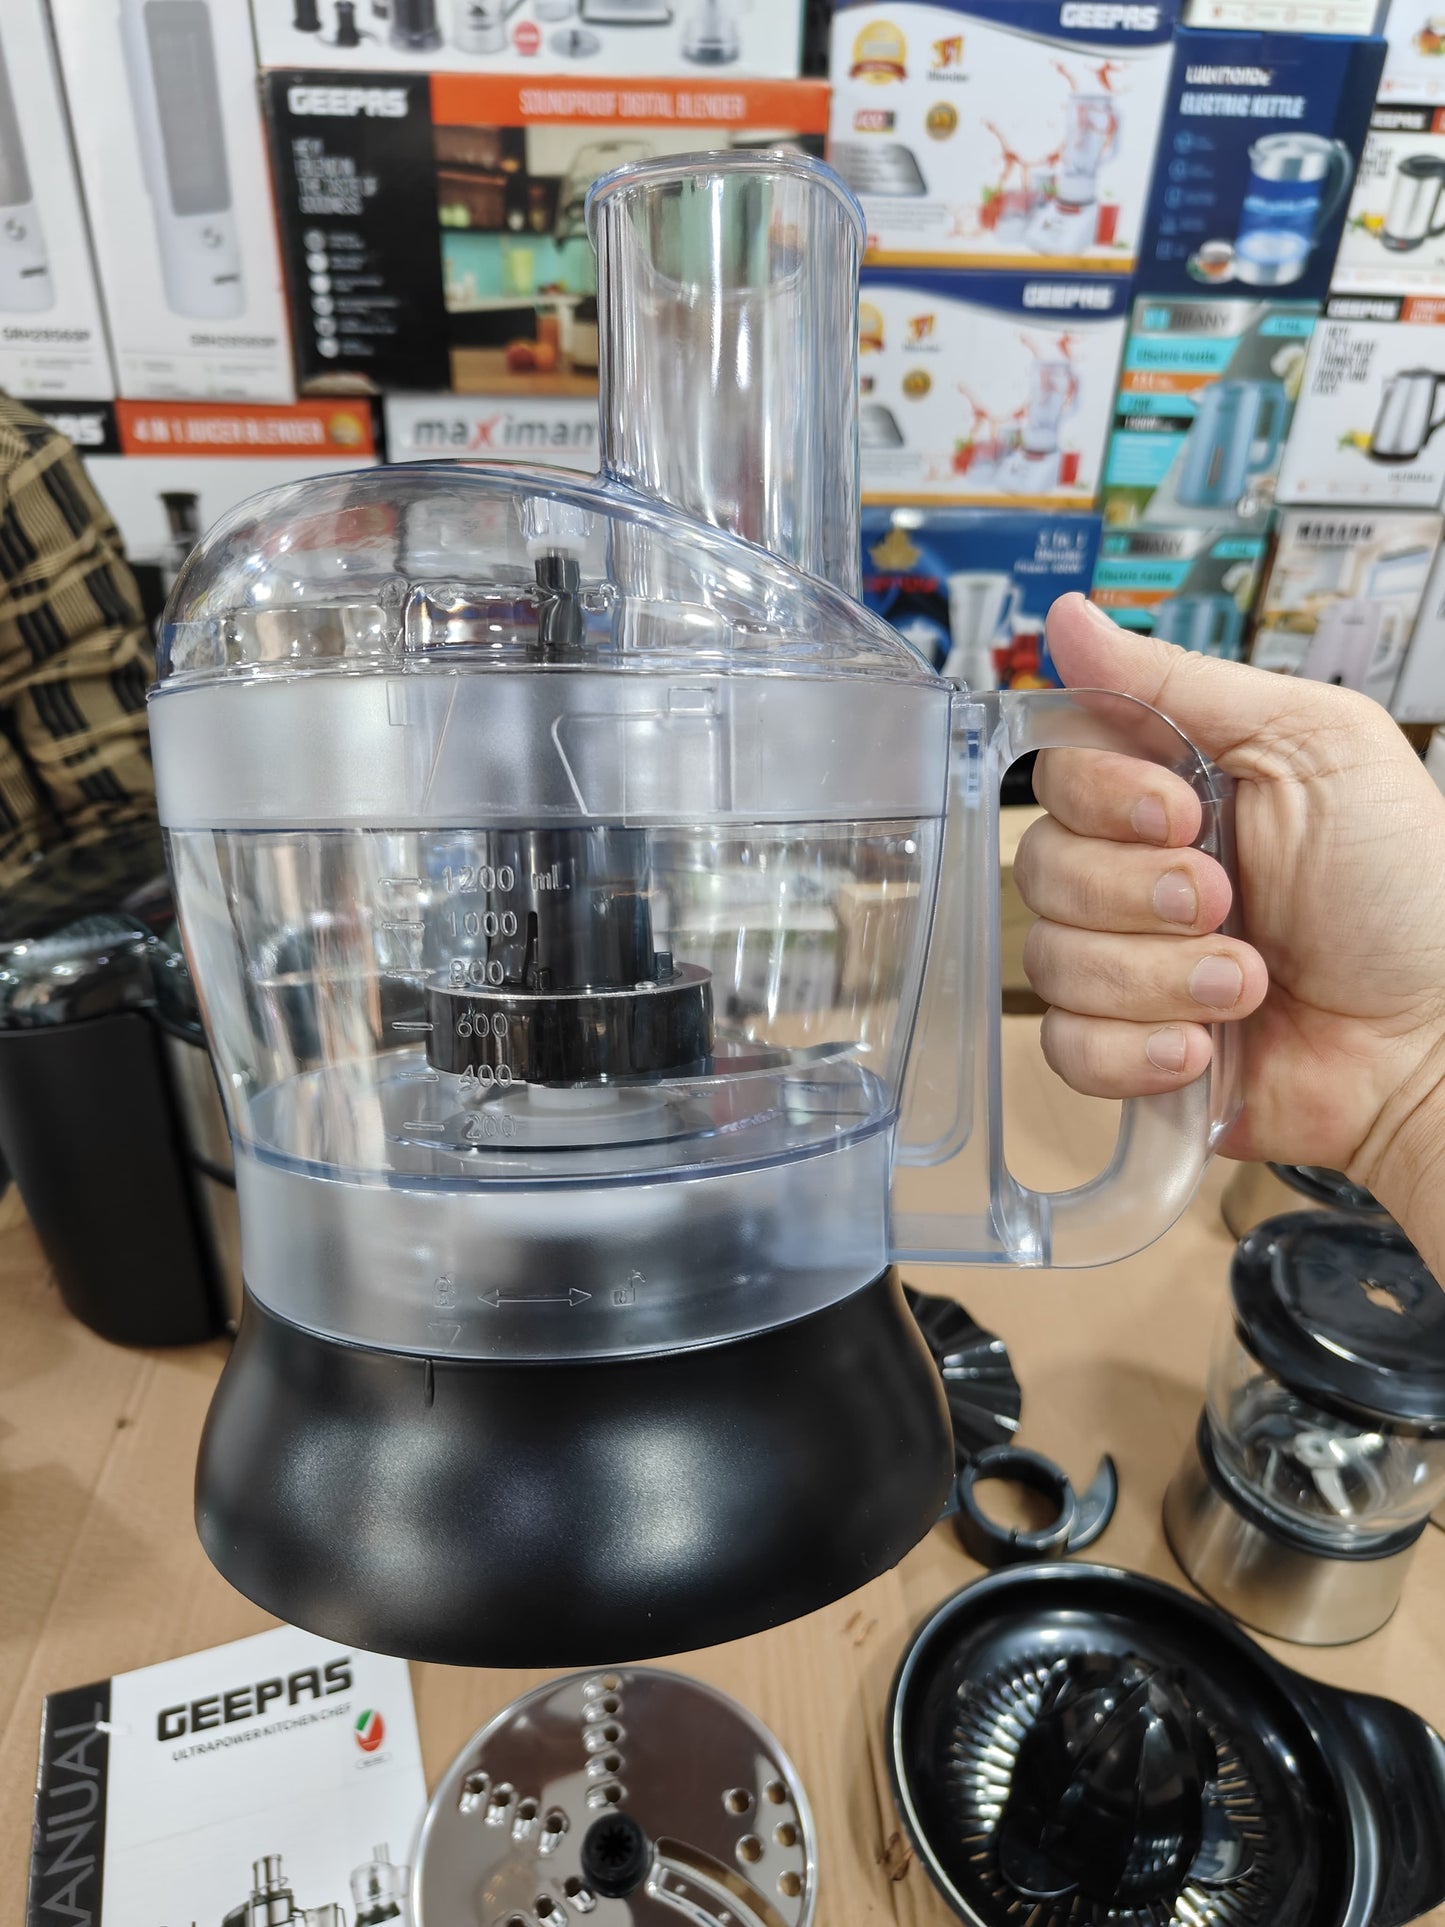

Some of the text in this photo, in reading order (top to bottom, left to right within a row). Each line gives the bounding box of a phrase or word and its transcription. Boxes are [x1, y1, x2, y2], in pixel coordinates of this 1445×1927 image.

[1060, 3, 1158, 31] GEEPAS
[287, 86, 408, 117] GEEPAS
[519, 89, 746, 119] SOUNDPROOF DIGITAL BLENDER
[443, 865, 514, 894] 1200
[451, 911, 518, 937] 1000
[450, 959, 505, 985] 800
[457, 1011, 508, 1038] 600
[458, 1063, 512, 1090] 400
[465, 1114, 517, 1139] 200
[158, 1656, 352, 1741] GEEPAS
[40, 1702, 102, 1927] ANUAL
